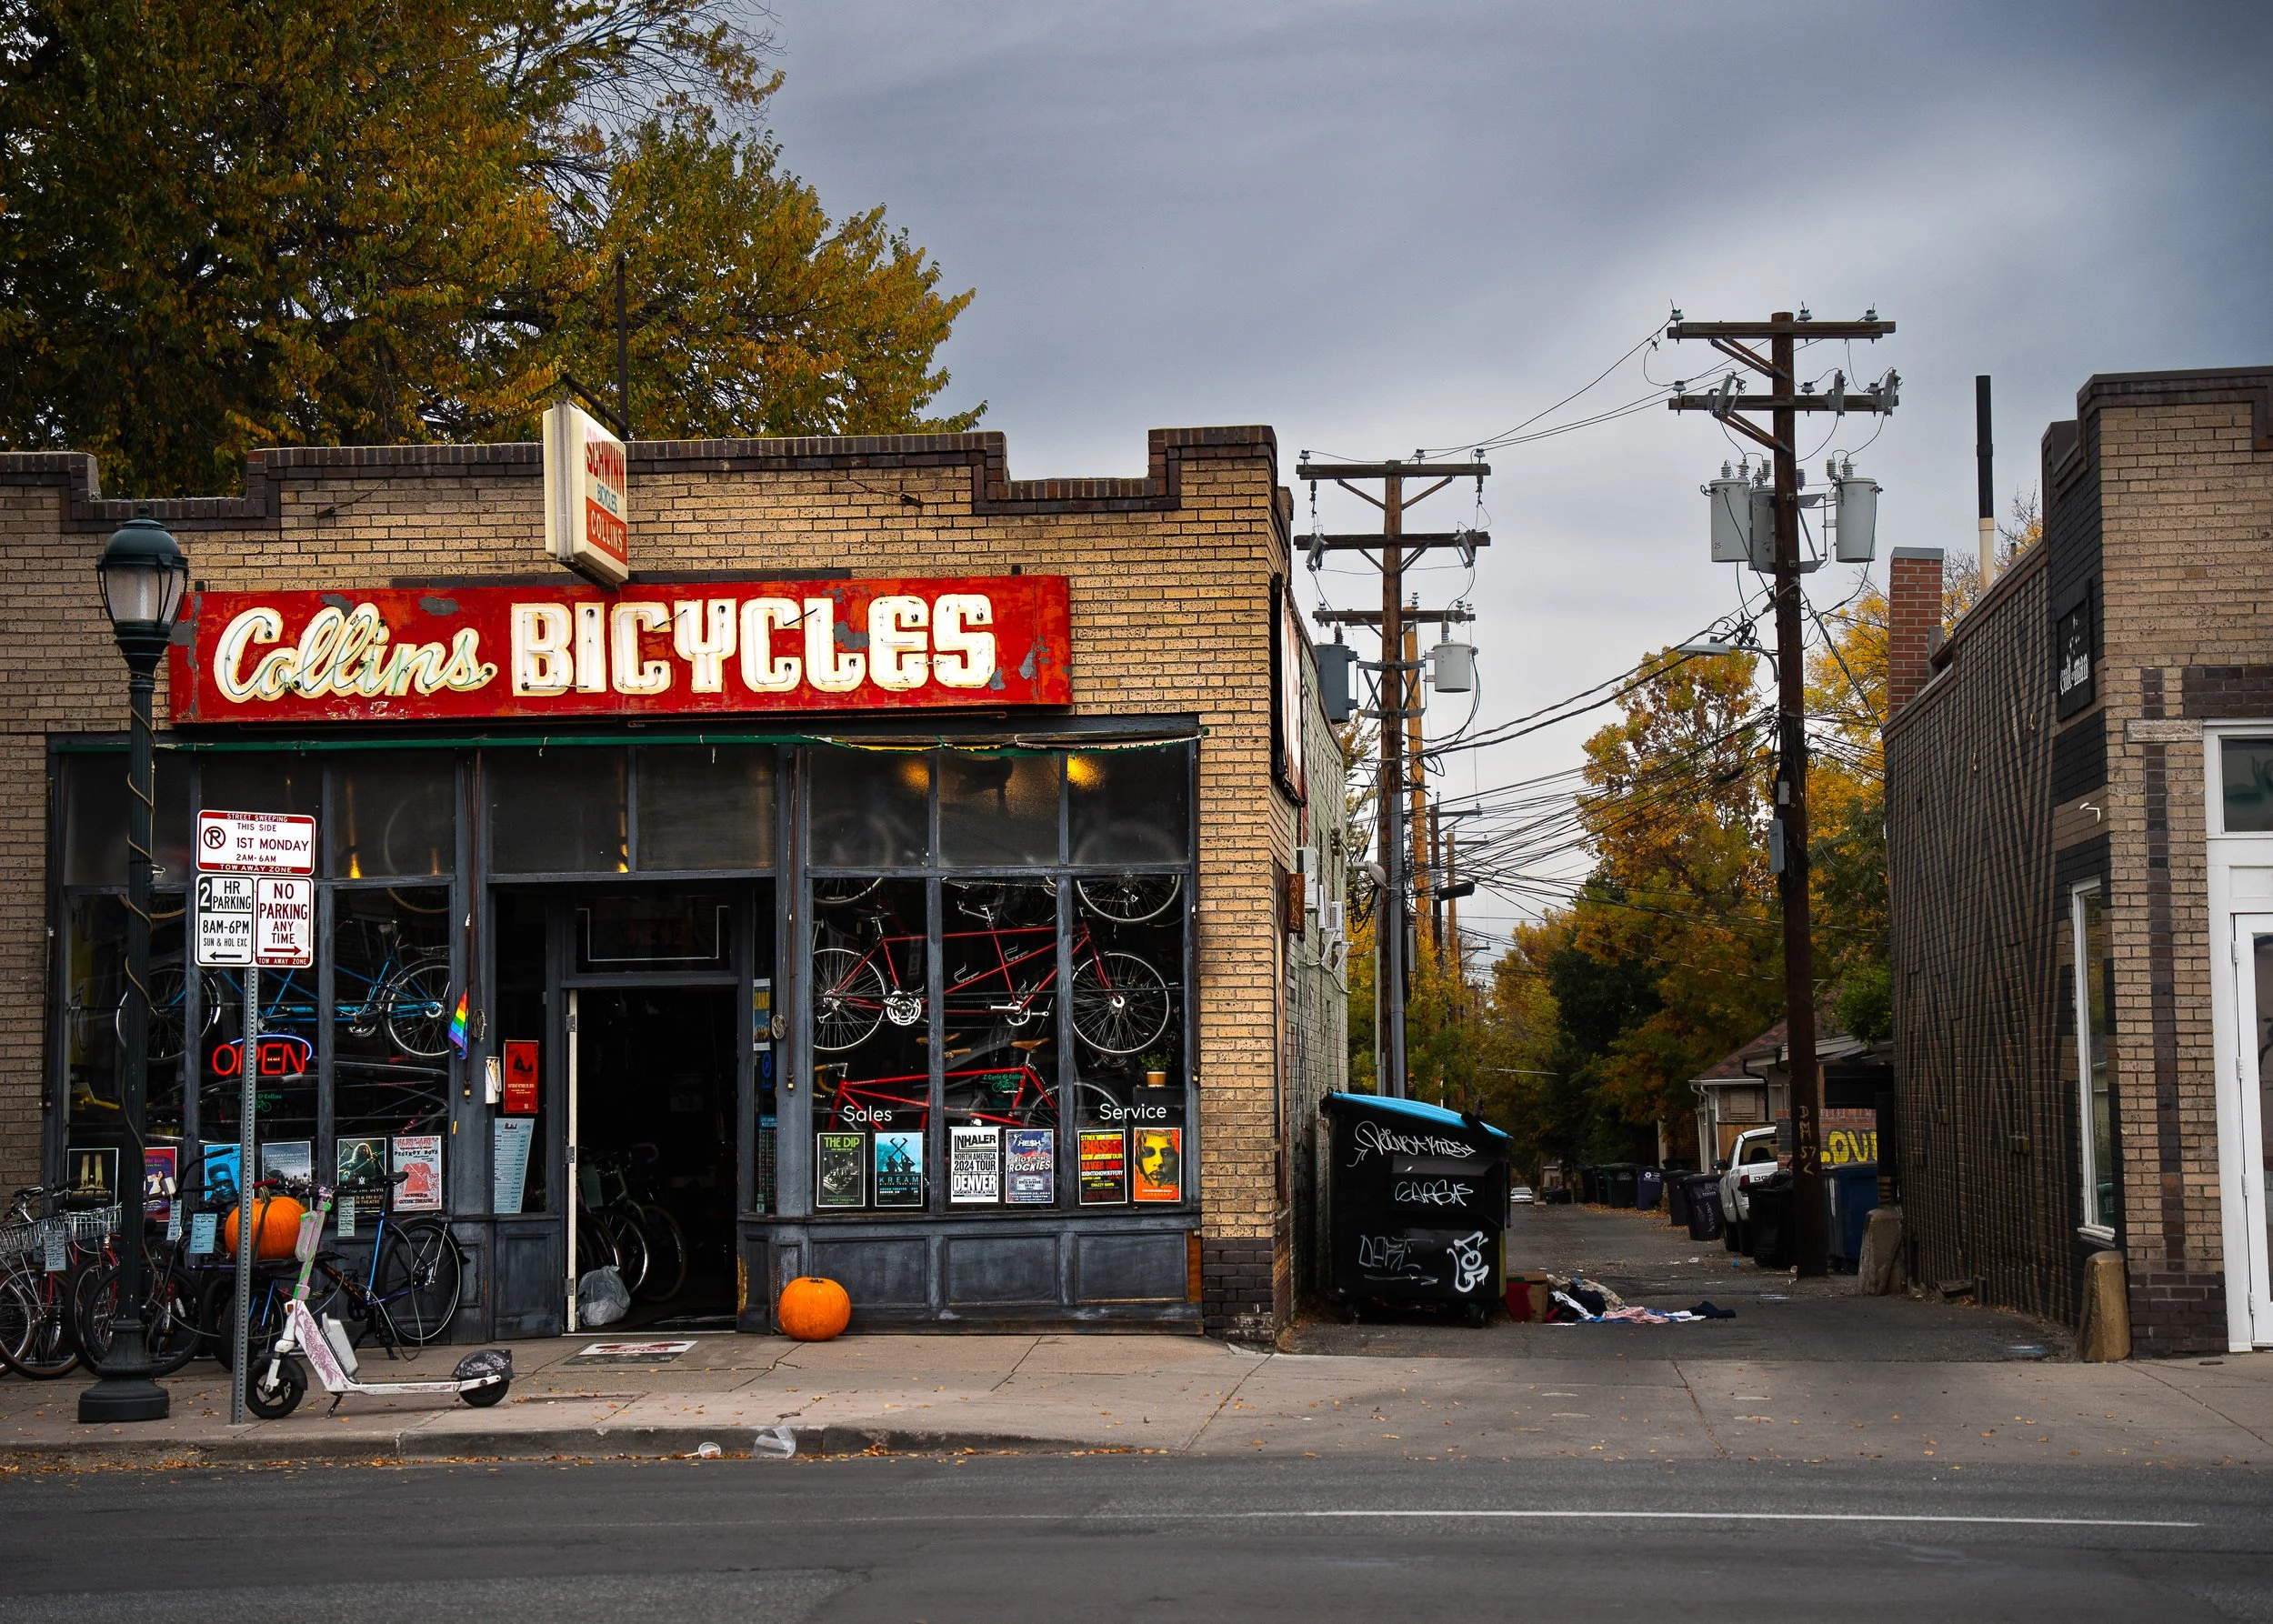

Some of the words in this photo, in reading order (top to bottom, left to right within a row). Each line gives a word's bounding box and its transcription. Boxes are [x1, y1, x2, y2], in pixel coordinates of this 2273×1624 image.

[586, 426, 625, 497] SCHWINN
[596, 483, 617, 515] BICYCLES
[213, 602, 498, 704] Collins
[510, 593, 997, 698] BICYCLES
[226, 813, 251, 821] STREET
[255, 815, 288, 823] SWEEPING
[236, 823, 255, 831] THIS
[258, 824, 277, 832] SIDE
[236, 837, 255, 848] 1ST
[259, 838, 309, 852] MONDAY
[268, 866, 293, 874] ZONE
[199, 882, 211, 907] 2
[224, 881, 241, 895] HR
[274, 883, 295, 899] NO
[213, 896, 252, 910] PARKING
[259, 903, 308, 920] PARKING
[202, 919, 249, 935] 8AM-6PM
[273, 921, 294, 932] ANY
[203, 937, 215, 947] SUN
[216, 938, 222, 947] &
[224, 938, 235, 947] HOL
[236, 938, 247, 947] EXC
[271, 933, 295, 944] TIME
[843, 1105, 893, 1123] Sales
[1099, 1103, 1167, 1120] Service
[824, 1137, 841, 1148] THE
[844, 1137, 860, 1148] DIP
[954, 1134, 996, 1148] INHALER
[1820, 1130, 1877, 1164] OV
[954, 1152, 972, 1161] NORTH
[973, 1152, 996, 1161] AMERICA
[1014, 1156, 1032, 1164] RIOT
[954, 1160, 975, 1171] 2024
[976, 1160, 996, 1171] TOUR
[1008, 1160, 1051, 1173] ROCKIES
[953, 1174, 997, 1191] DENVER
